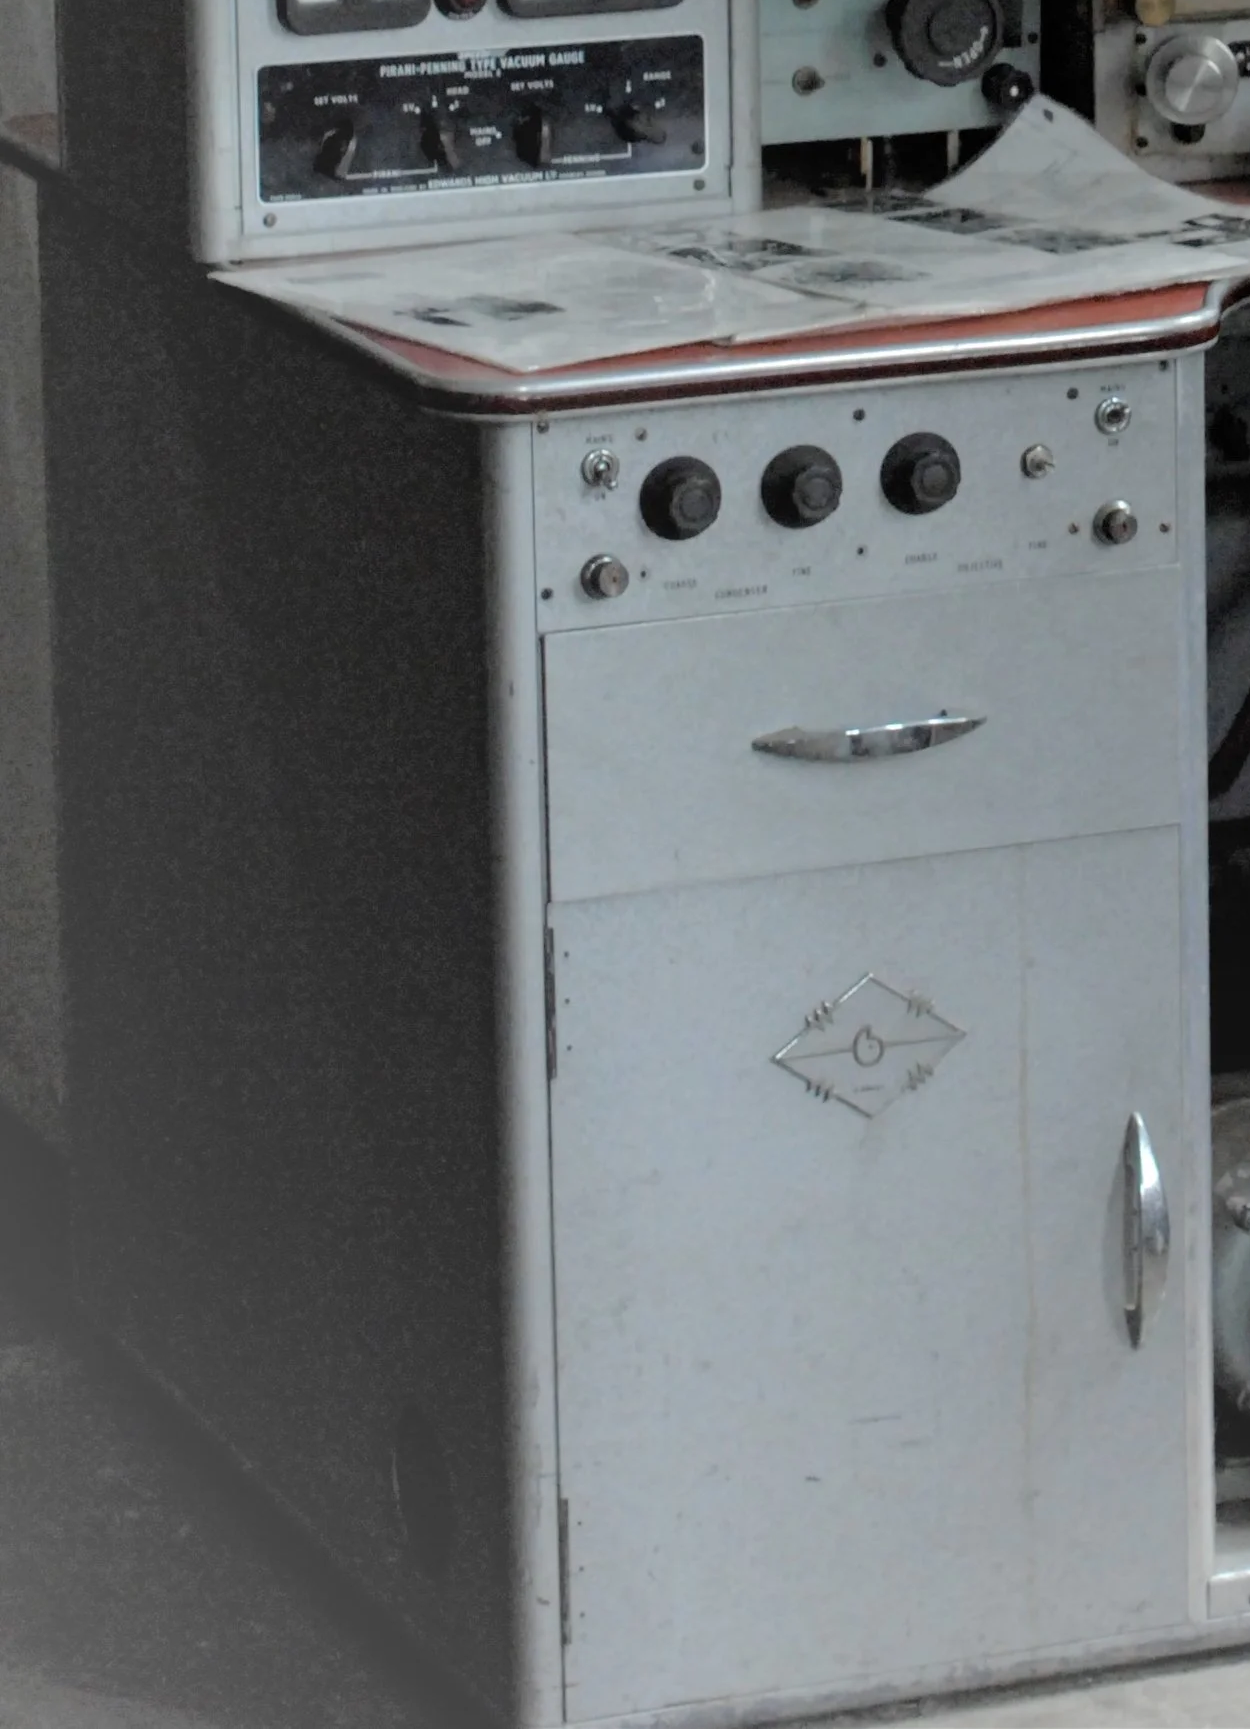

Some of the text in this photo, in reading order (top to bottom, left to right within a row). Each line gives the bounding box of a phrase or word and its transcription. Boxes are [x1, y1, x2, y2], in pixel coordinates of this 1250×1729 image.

[470, 59, 497, 71] TYPE
[501, 54, 546, 70] VACUUM
[549, 50, 585, 65] GAUGE
[428, 177, 472, 189] EDWARDS
[474, 174, 499, 186] HIGH
[501, 172, 543, 184] VACUUM
